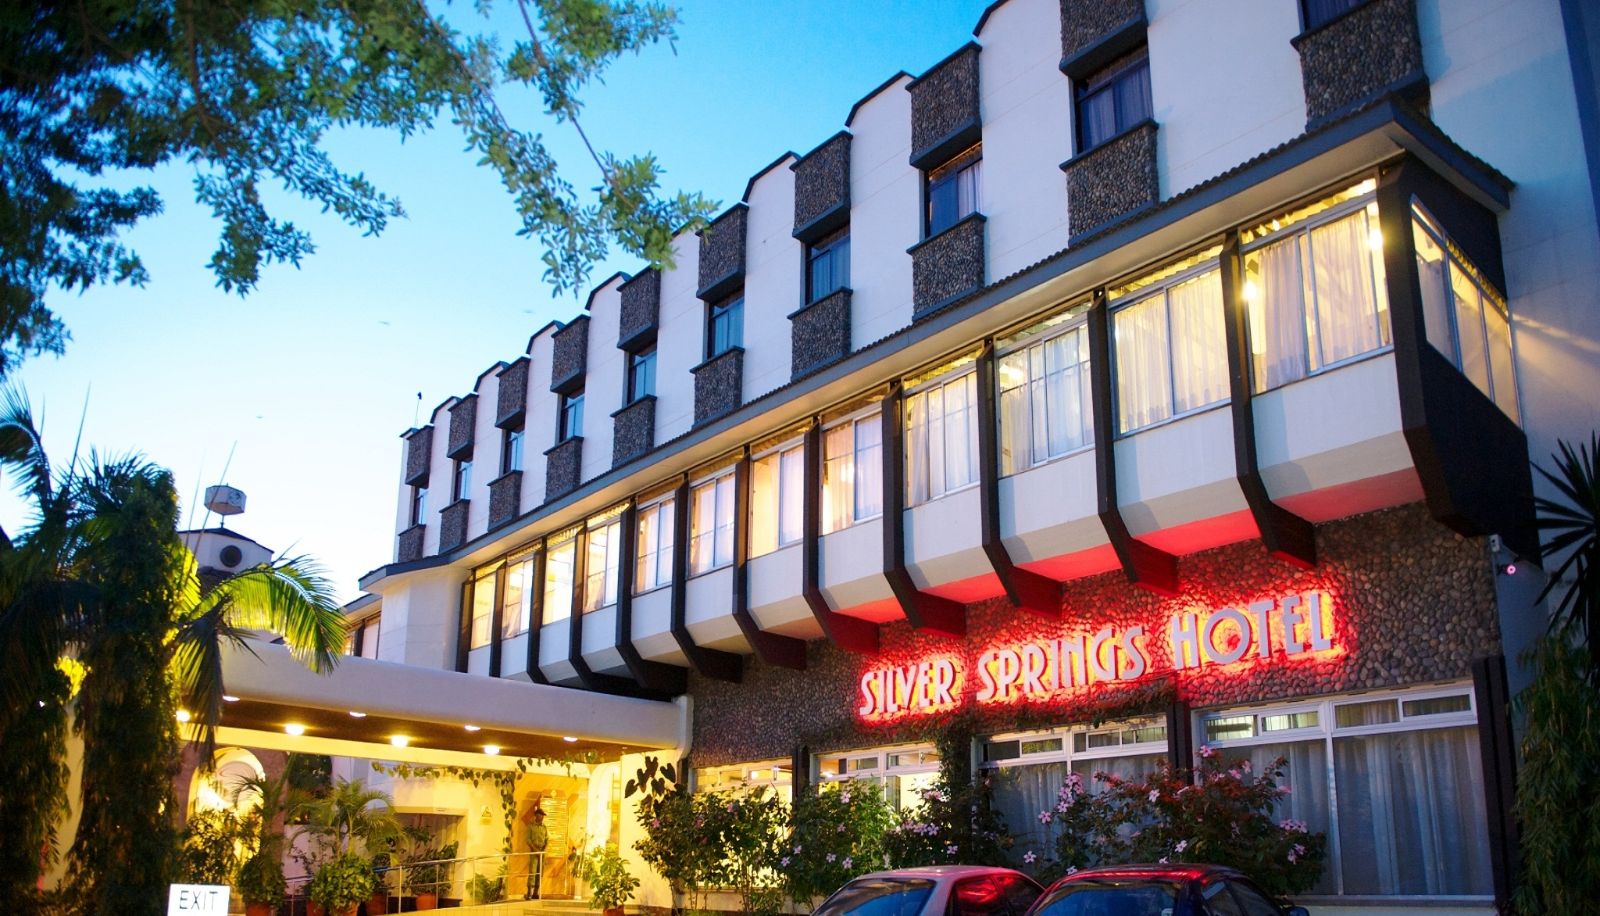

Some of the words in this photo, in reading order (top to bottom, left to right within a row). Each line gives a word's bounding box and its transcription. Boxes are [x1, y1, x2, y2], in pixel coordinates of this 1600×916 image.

[859, 659, 956, 715] SILVER
[976, 627, 1146, 701] SPRINGS
[1170, 593, 1333, 670] HOTEL
[179, 890, 218, 910] EXIT
